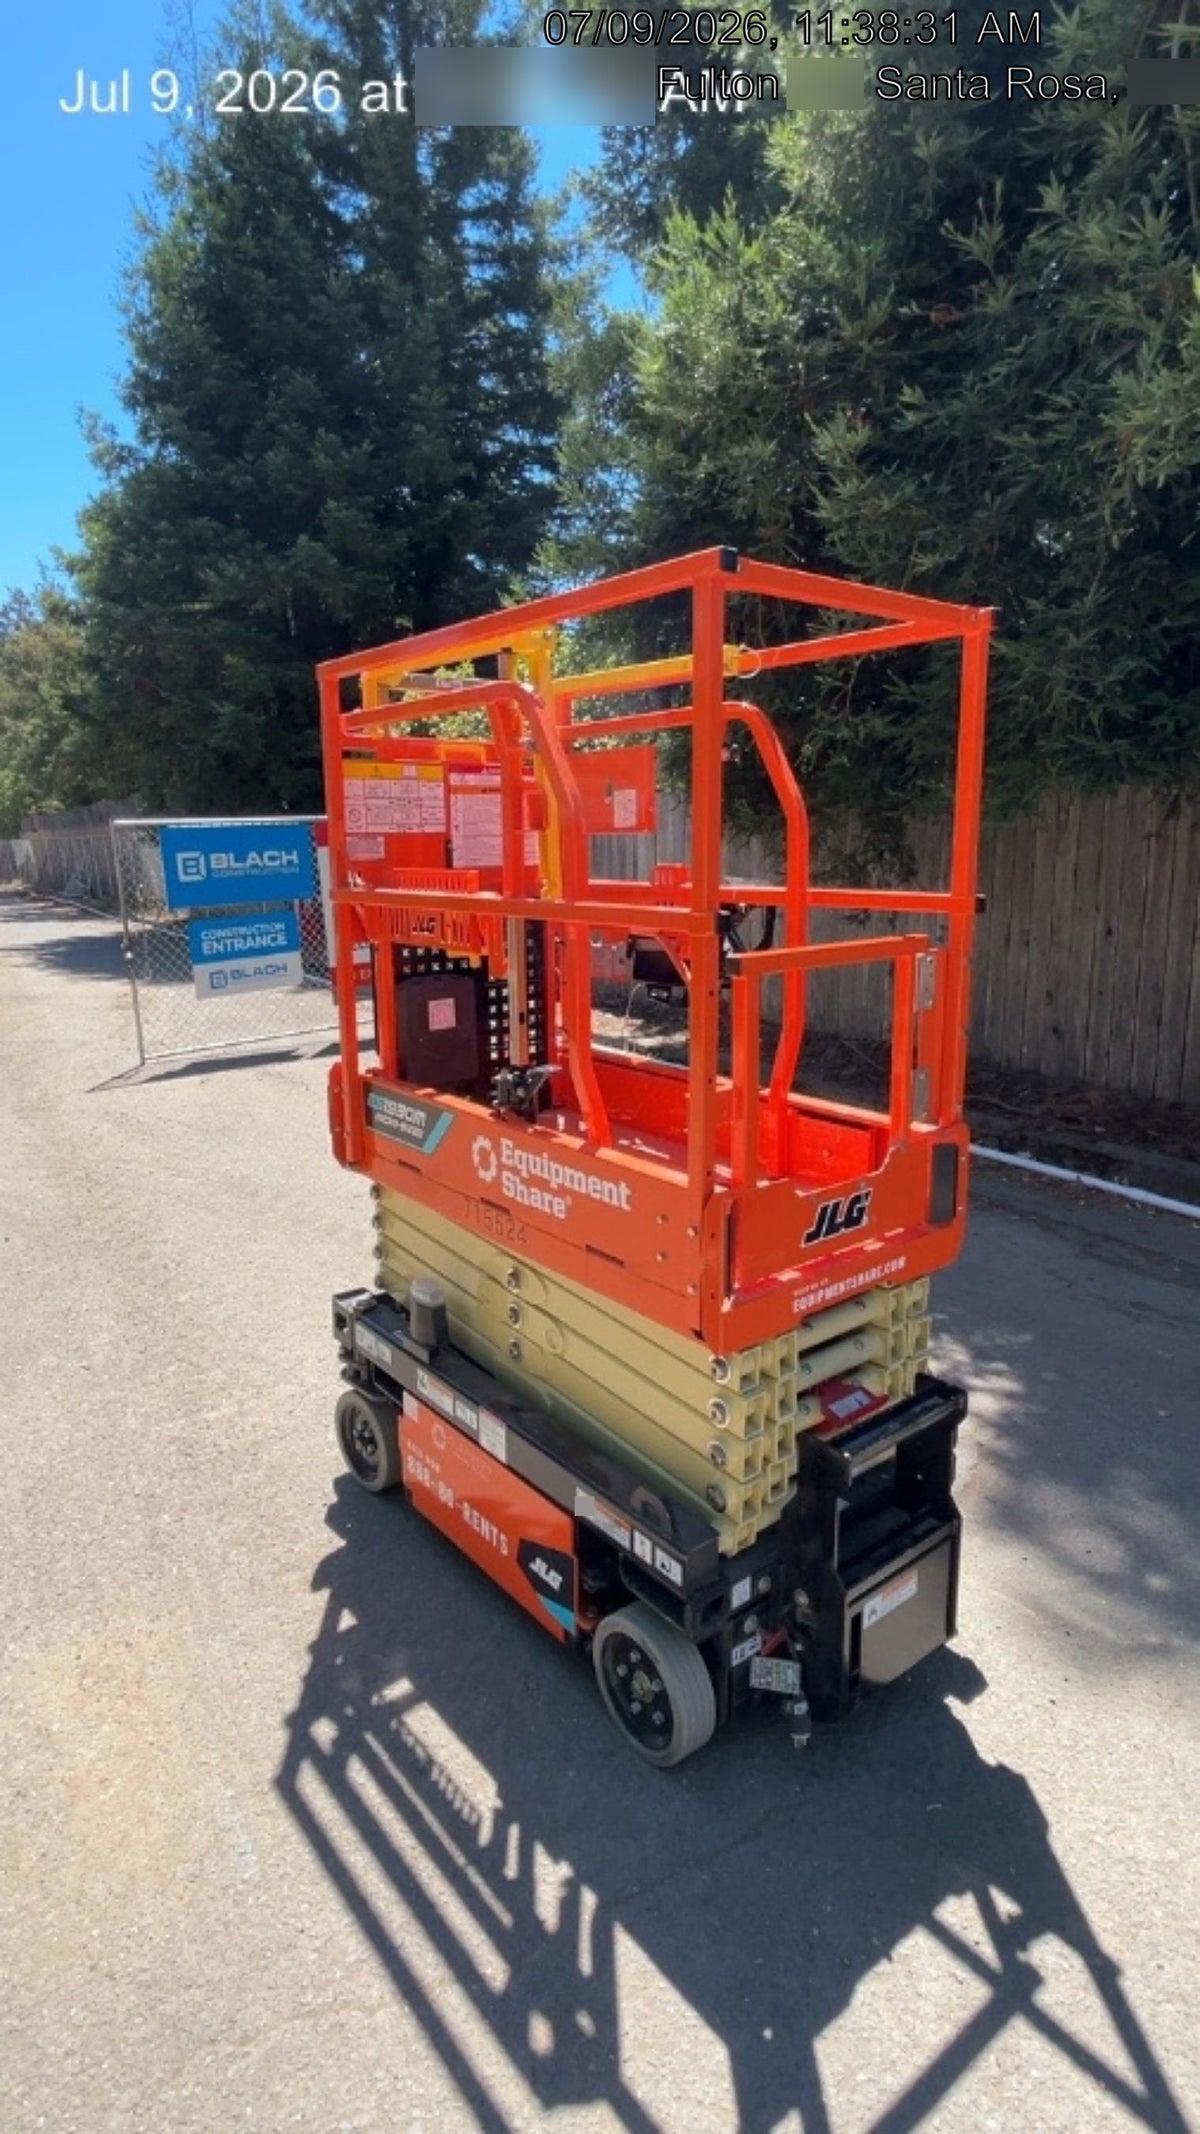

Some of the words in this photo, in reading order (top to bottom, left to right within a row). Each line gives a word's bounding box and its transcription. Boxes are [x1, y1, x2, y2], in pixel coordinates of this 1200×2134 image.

[210, 849, 299, 869] BLACH
[201, 922, 286, 940] CONSTRUCTION
[202, 931, 288, 955] ENTRANCE
[229, 963, 288, 980] BLACH
[500, 1138, 632, 1211] Equipment
[502, 1170, 569, 1219] Share
[801, 1188, 873, 1247] JLG
[528, 1557, 563, 1591] JLG
